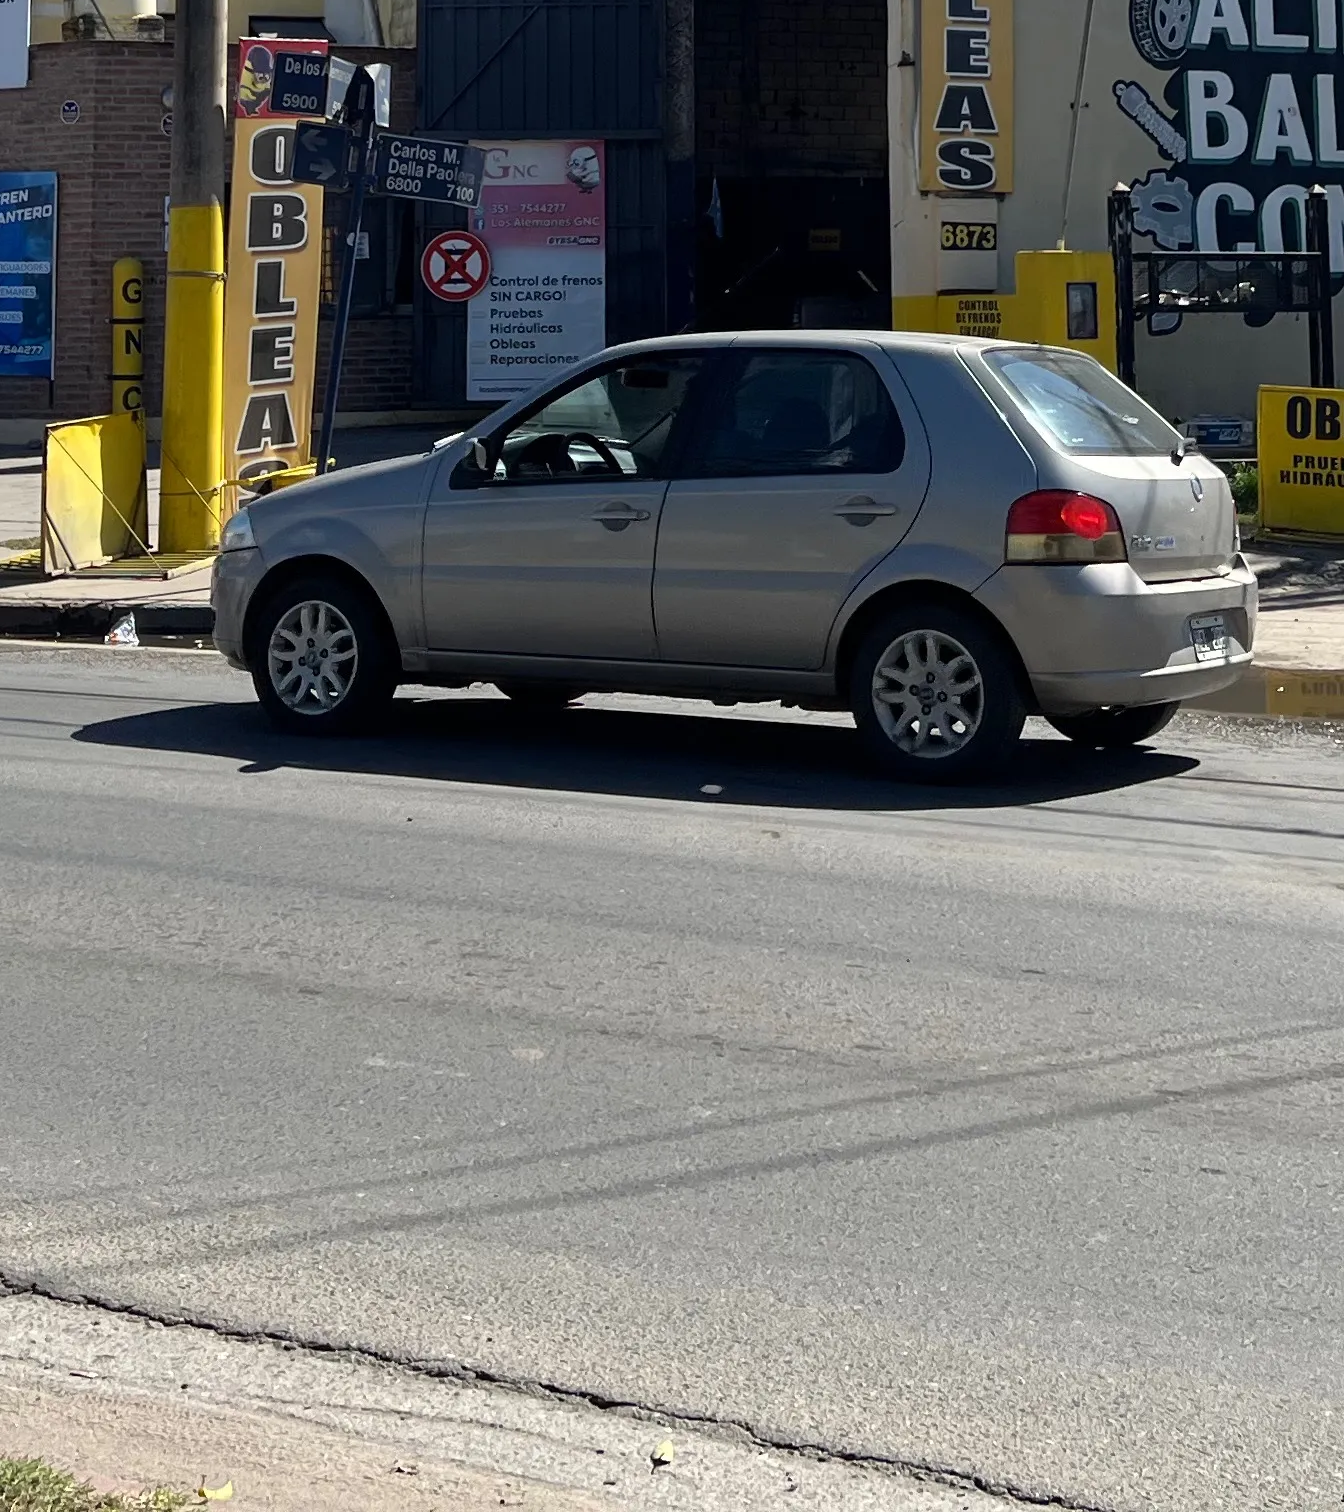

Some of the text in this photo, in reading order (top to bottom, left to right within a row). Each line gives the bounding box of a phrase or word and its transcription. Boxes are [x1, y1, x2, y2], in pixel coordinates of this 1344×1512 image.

[285, 57, 301, 74] De
[303, 59, 320, 76] los
[282, 93, 317, 110] 5900
[390, 140, 461, 165] Carlos M.
[388, 159, 475, 186] Della Paolera
[386, 176, 474, 202] 6800 7100
[491, 203, 565, 214] 351 7544277
[491, 215, 600, 228] Los Alemanes GNC
[941, 224, 995, 248] 6873
[490, 274, 603, 287] Control de frenos
[490, 290, 566, 302] SIN CARGO!
[958, 300, 999, 311] CONTROL
[490, 307, 543, 319] Pruebas
[956, 312, 1002, 324] DE FRENOS
[490, 322, 563, 334] Hidráulicas
[122, 277, 143, 411] GNC
[490, 338, 536, 350] Obleas
[490, 354, 579, 367] Reparaciones
